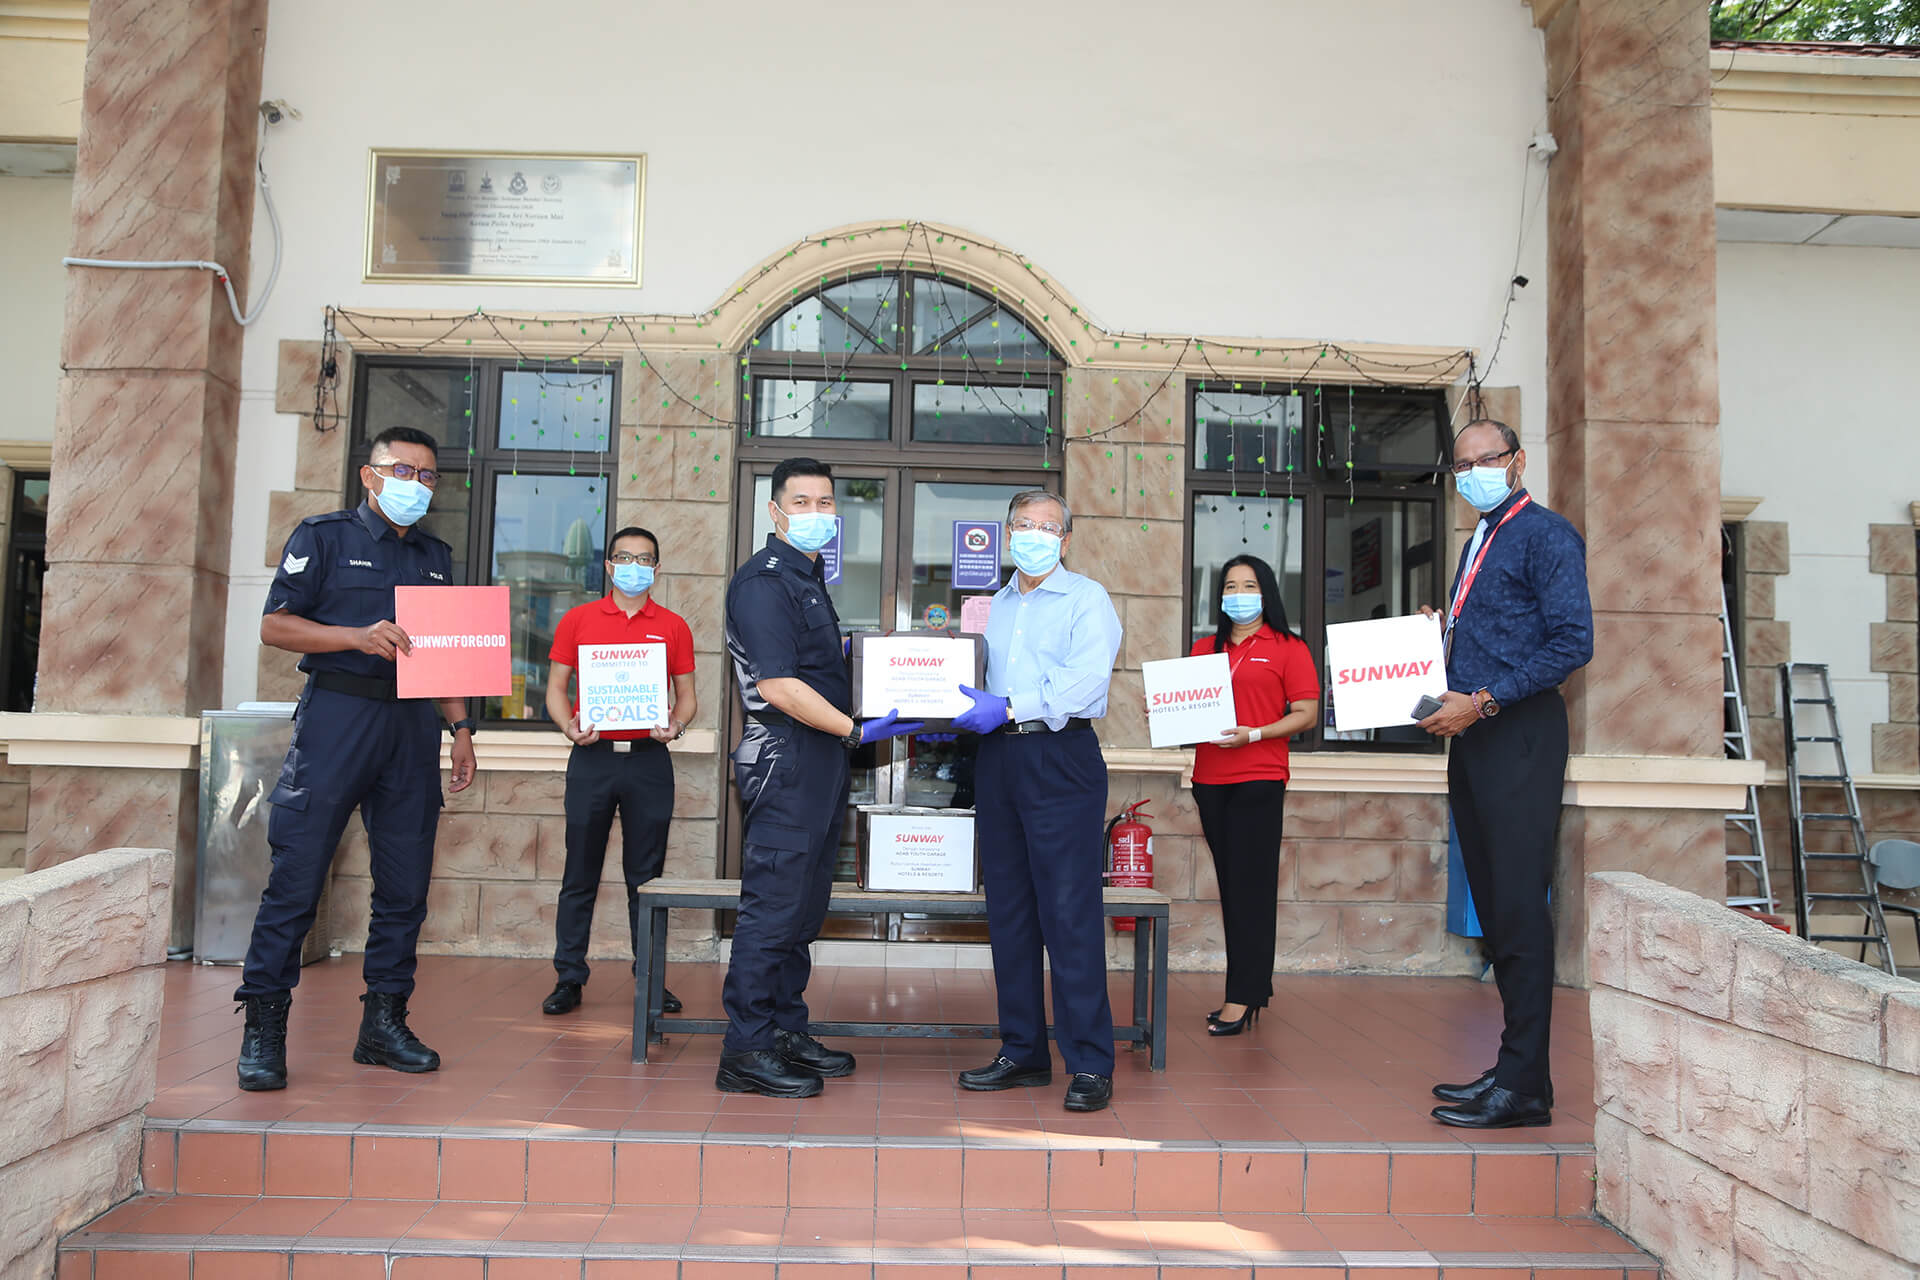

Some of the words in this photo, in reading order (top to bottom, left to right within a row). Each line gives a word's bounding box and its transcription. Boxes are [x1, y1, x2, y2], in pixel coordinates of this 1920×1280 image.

[591, 649, 649, 660] SUNWAY
[889, 656, 945, 667] SUNWAY
[1338, 660, 1433, 685] SUNWAY
[587, 684, 659, 695] SUSTAINABLE
[587, 694, 658, 705] DEVELOPMENT
[1152, 686, 1223, 706] SUNWAY
[588, 704, 659, 722] GOALS
[1152, 705, 1179, 714] HOTELS
[1188, 701, 1221, 710] RESORTS
[895, 833, 945, 843] SUNWAY
